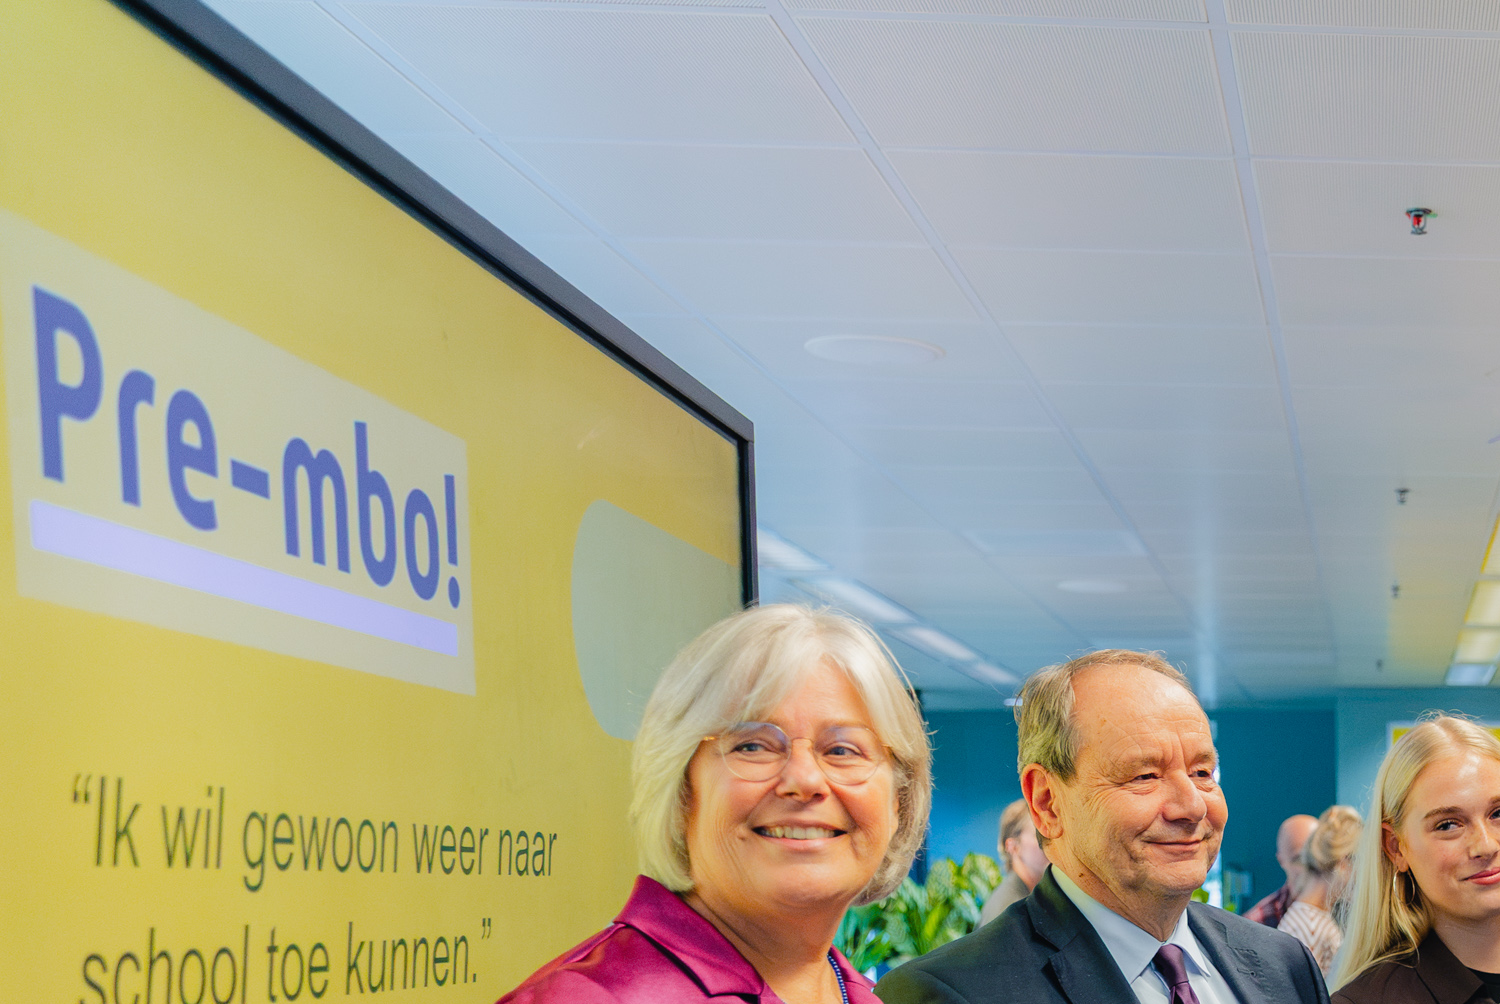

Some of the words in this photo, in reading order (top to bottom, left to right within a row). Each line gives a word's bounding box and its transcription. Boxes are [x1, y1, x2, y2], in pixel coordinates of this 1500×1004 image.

[28, 282, 462, 610] Pre-mbo!
[163, 786, 225, 869] wil
[243, 810, 399, 893] gewoon
[412, 822, 490, 876] weer
[497, 829, 559, 877] naar
[267, 928, 331, 1004] toe
